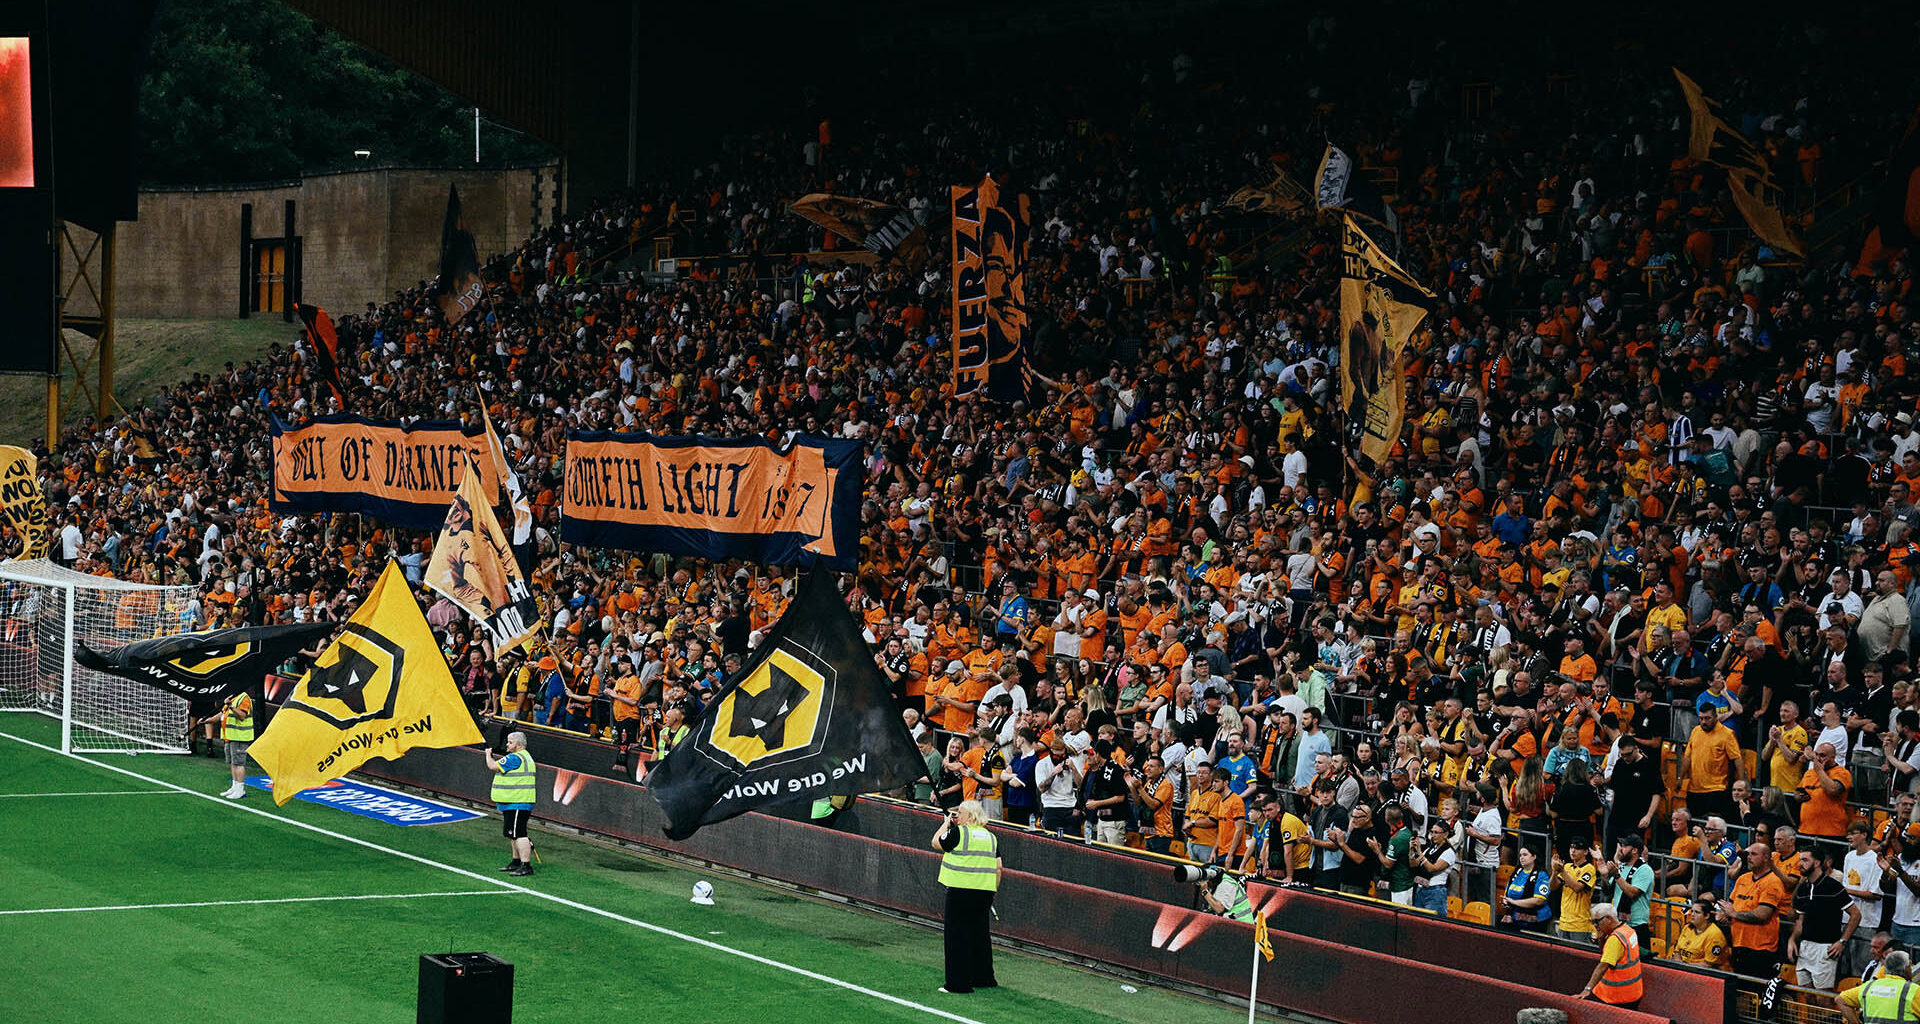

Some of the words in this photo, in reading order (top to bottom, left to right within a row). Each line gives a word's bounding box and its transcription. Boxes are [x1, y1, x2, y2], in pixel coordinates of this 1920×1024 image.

[955, 187, 988, 397] FUERZA
[290, 436, 327, 481] OUT
[341, 436, 373, 481] OF
[568, 456, 648, 510] COMETH
[656, 461, 750, 518] LIGHT
[762, 482, 816, 520] 187
